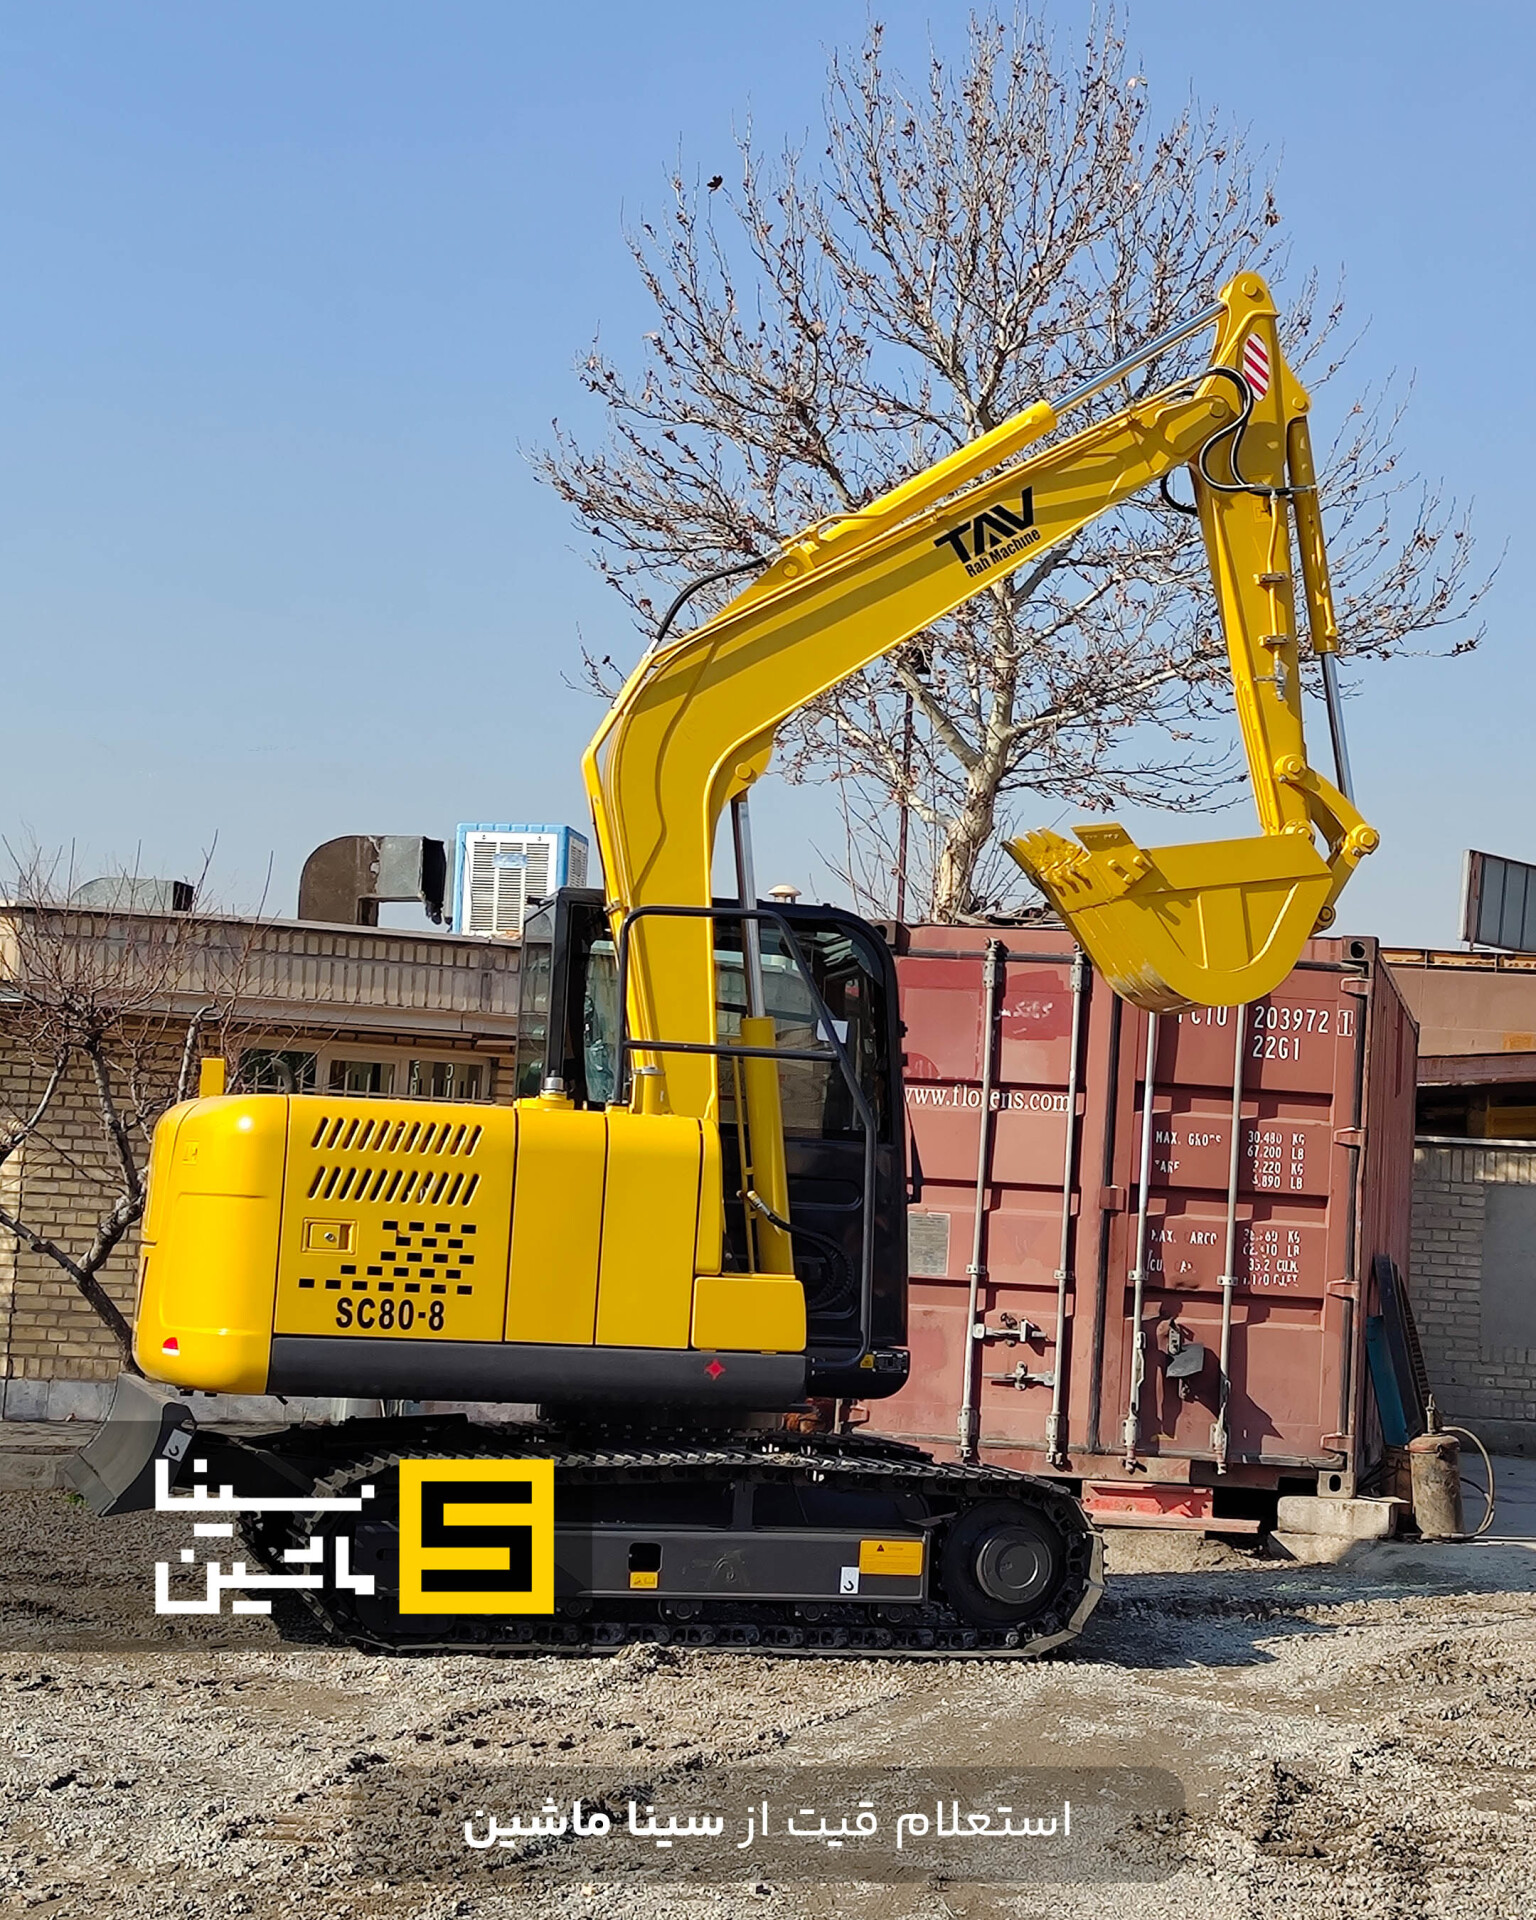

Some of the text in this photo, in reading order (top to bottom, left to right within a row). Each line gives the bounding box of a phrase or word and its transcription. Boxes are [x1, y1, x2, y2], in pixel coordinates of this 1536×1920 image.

[933, 486, 1034, 563] TAV
[965, 529, 1041, 577] Rah Machine
[1253, 1005, 1329, 1034] 203972
[1253, 1035, 1300, 1060] 22G1
[905, 1084, 1070, 1111] www.floens.com
[1248, 1130, 1283, 1144] 30.480
[1292, 1133, 1305, 1146] KG
[1247, 1145, 1304, 1160] 67.200 LB
[1290, 1177, 1303, 1190] LB
[336, 1297, 444, 1331] SC80-8
